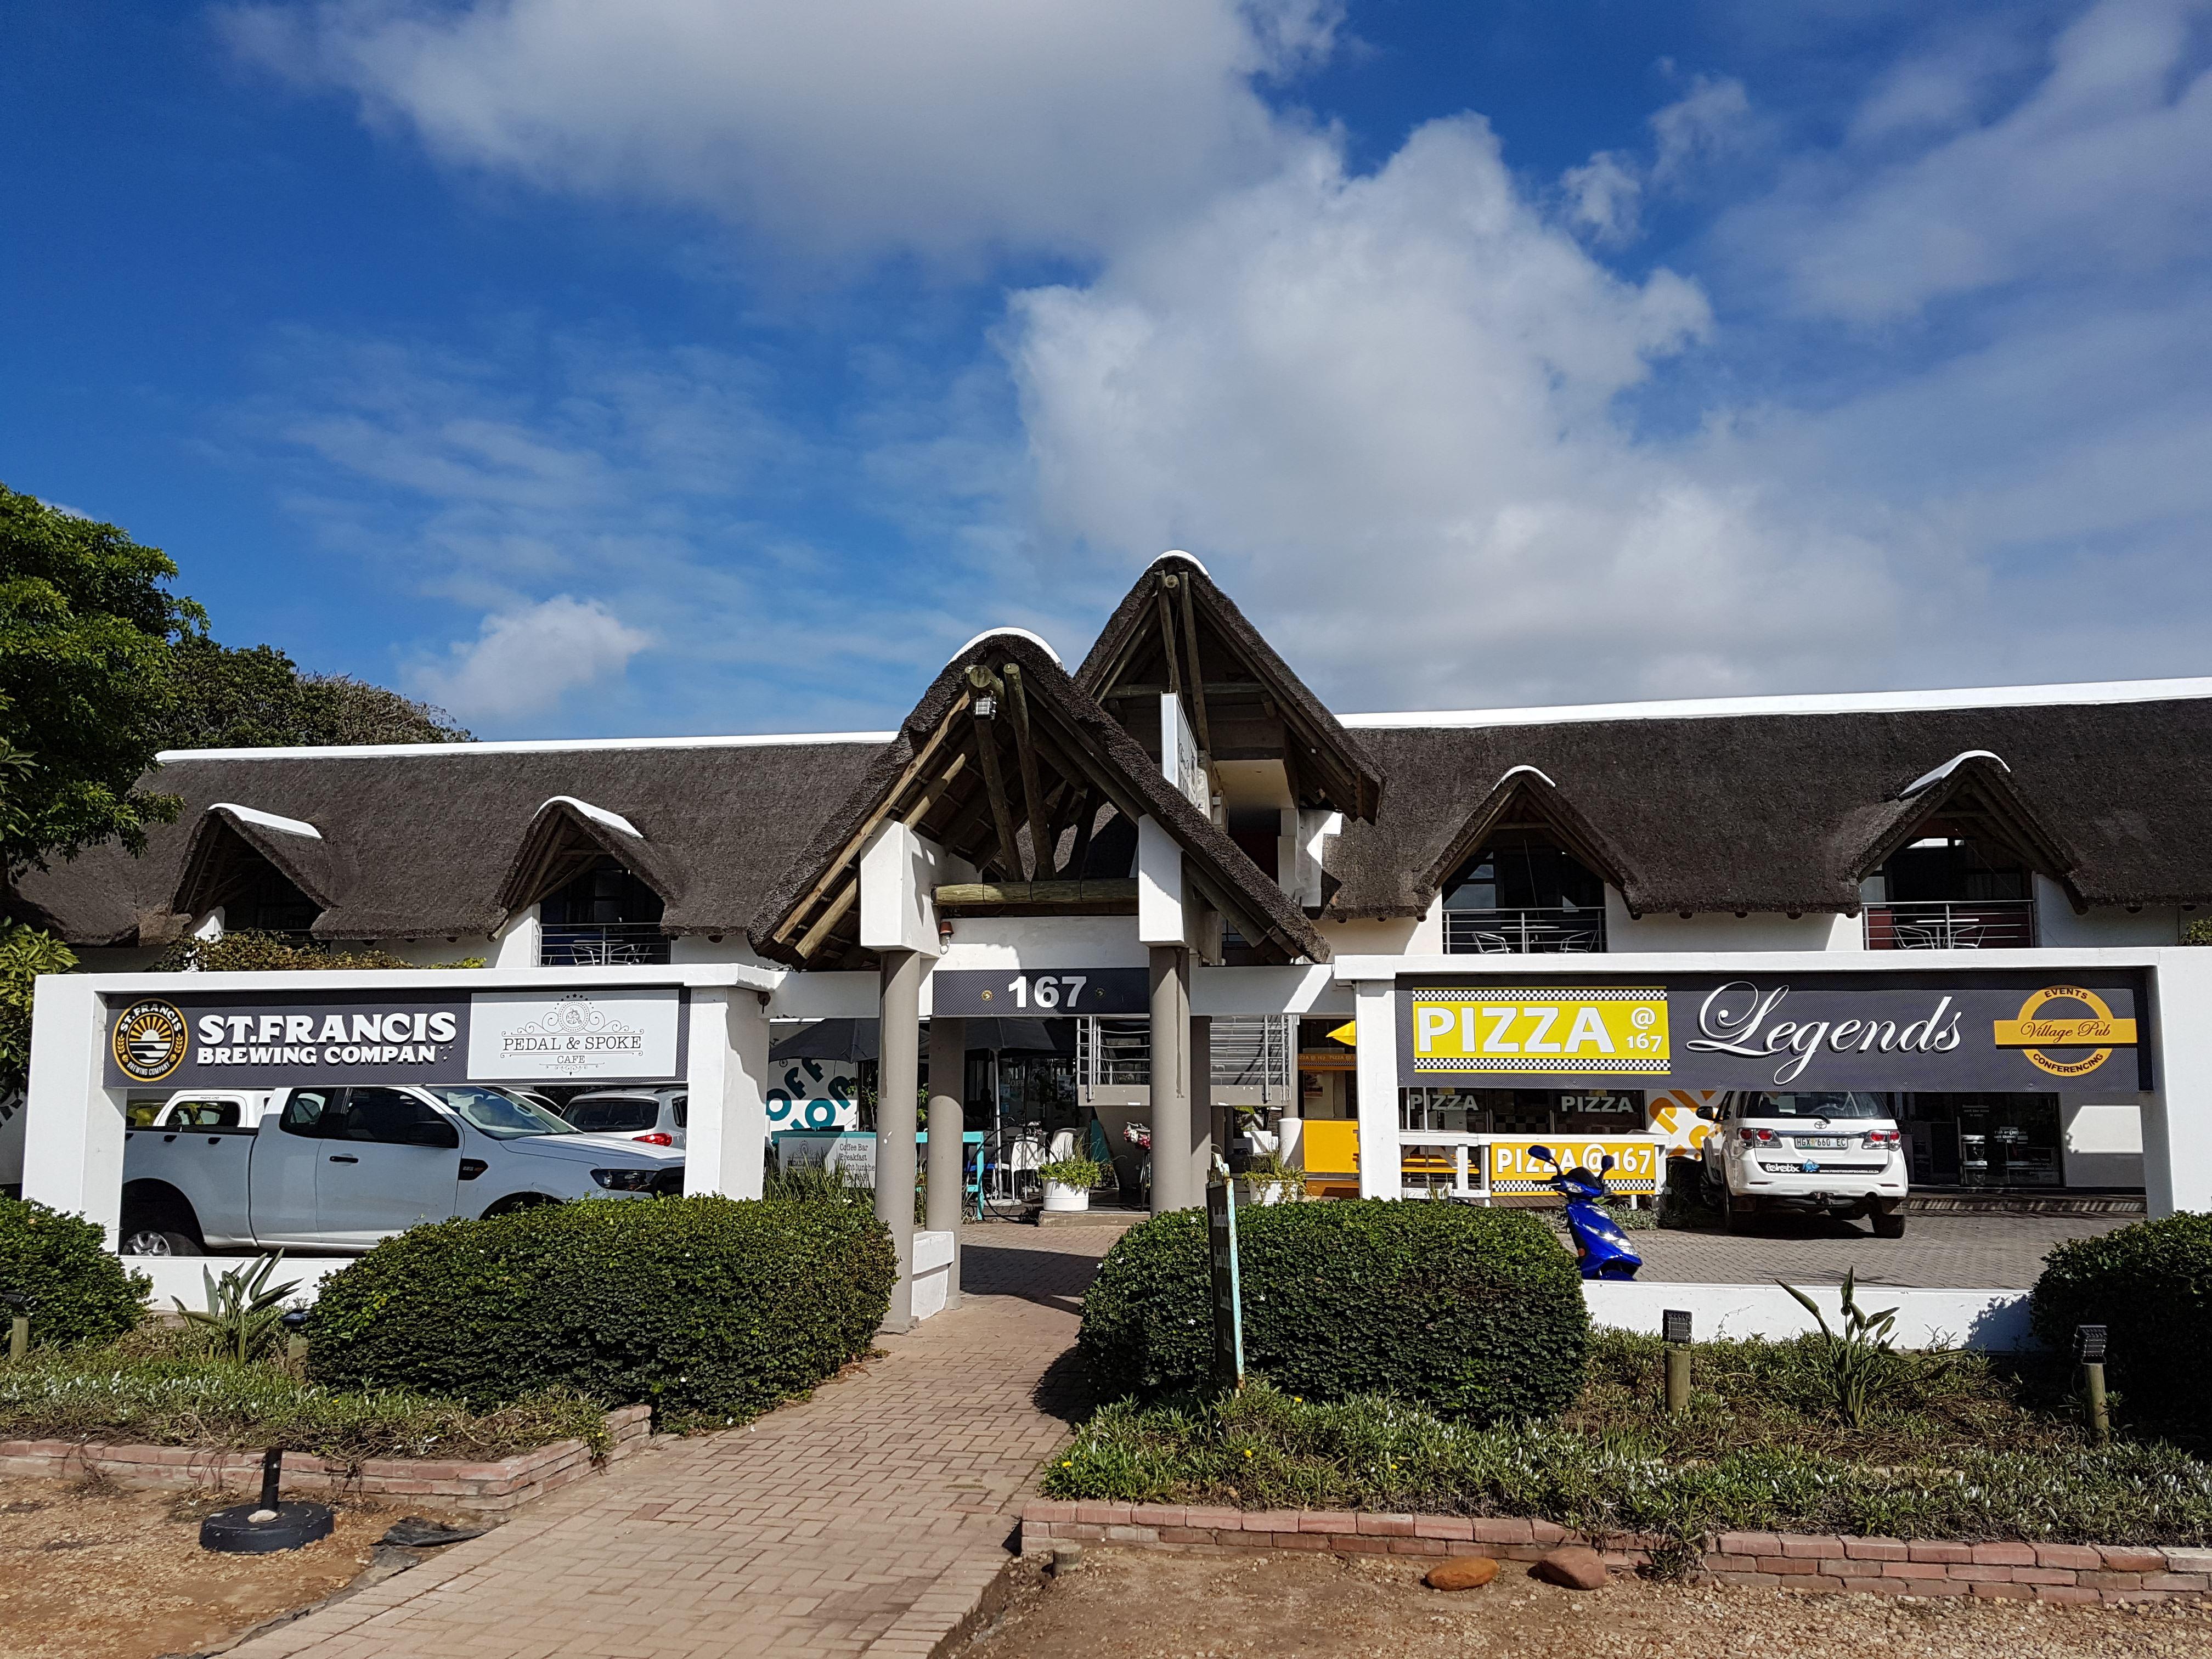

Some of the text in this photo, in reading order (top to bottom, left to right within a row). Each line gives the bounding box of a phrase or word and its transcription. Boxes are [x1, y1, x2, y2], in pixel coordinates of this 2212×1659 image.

[1008, 975, 1087, 1008] 167
[2044, 988, 2088, 1000] EVENTS
[198, 1012, 456, 1045] ST.FRANCIS
[1418, 1007, 1656, 1053] PIZZA @
[1686, 981, 1962, 1085] Legends
[2021, 1020, 2111, 1043] Village Pub
[503, 1036, 642, 1051] PEDAL & SPOKE
[1627, 1032, 1663, 1052] 167
[197, 1045, 436, 1064] BREWING COMPAN
[557, 1055, 585, 1064] CAFE
[2033, 1053, 2103, 1073] CONFERENCING
[1410, 1093, 1479, 1111] PIZZA
[1561, 1096, 1634, 1113] PIZZA
[1797, 1138, 1847, 1147] HGX 660 EC
[1765, 1163, 1801, 1172] fishstix
